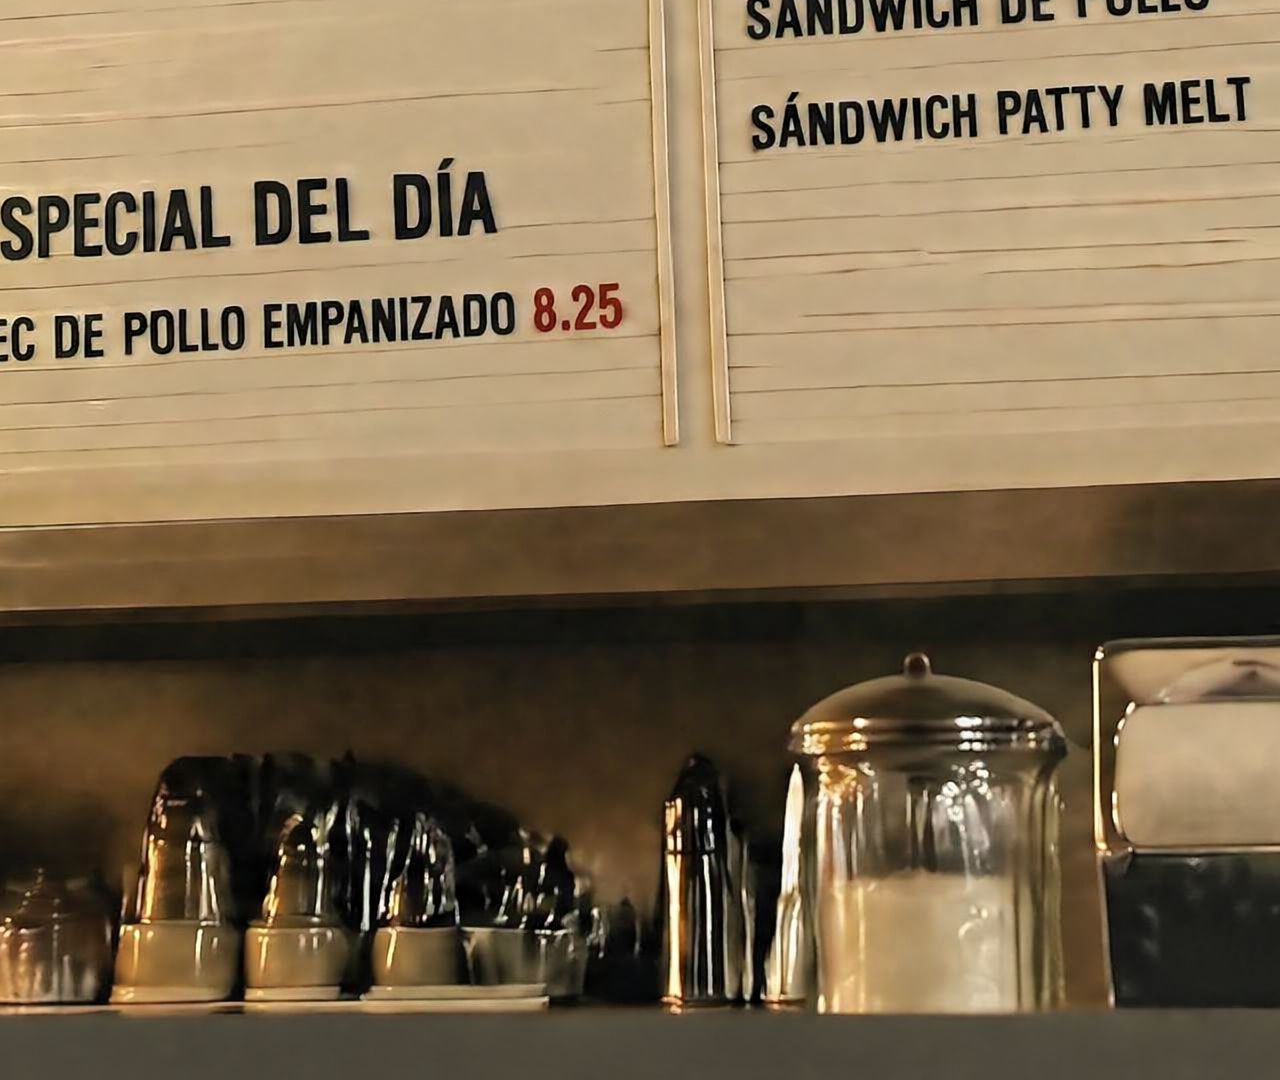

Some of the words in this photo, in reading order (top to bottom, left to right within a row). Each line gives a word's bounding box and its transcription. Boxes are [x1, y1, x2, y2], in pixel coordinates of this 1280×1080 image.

[750, 91, 978, 152] SÁNDWICH
[996, 84, 1124, 135] PATTY
[1143, 76, 1251, 126] MELT
[253, 177, 370, 246] DEL
[393, 157, 498, 241] DÍA
[54, 313, 105, 359] DE
[124, 305, 246, 356] POLLO
[263, 291, 516, 349] EMPANIZADO
[531, 282, 624, 333] 8.25
